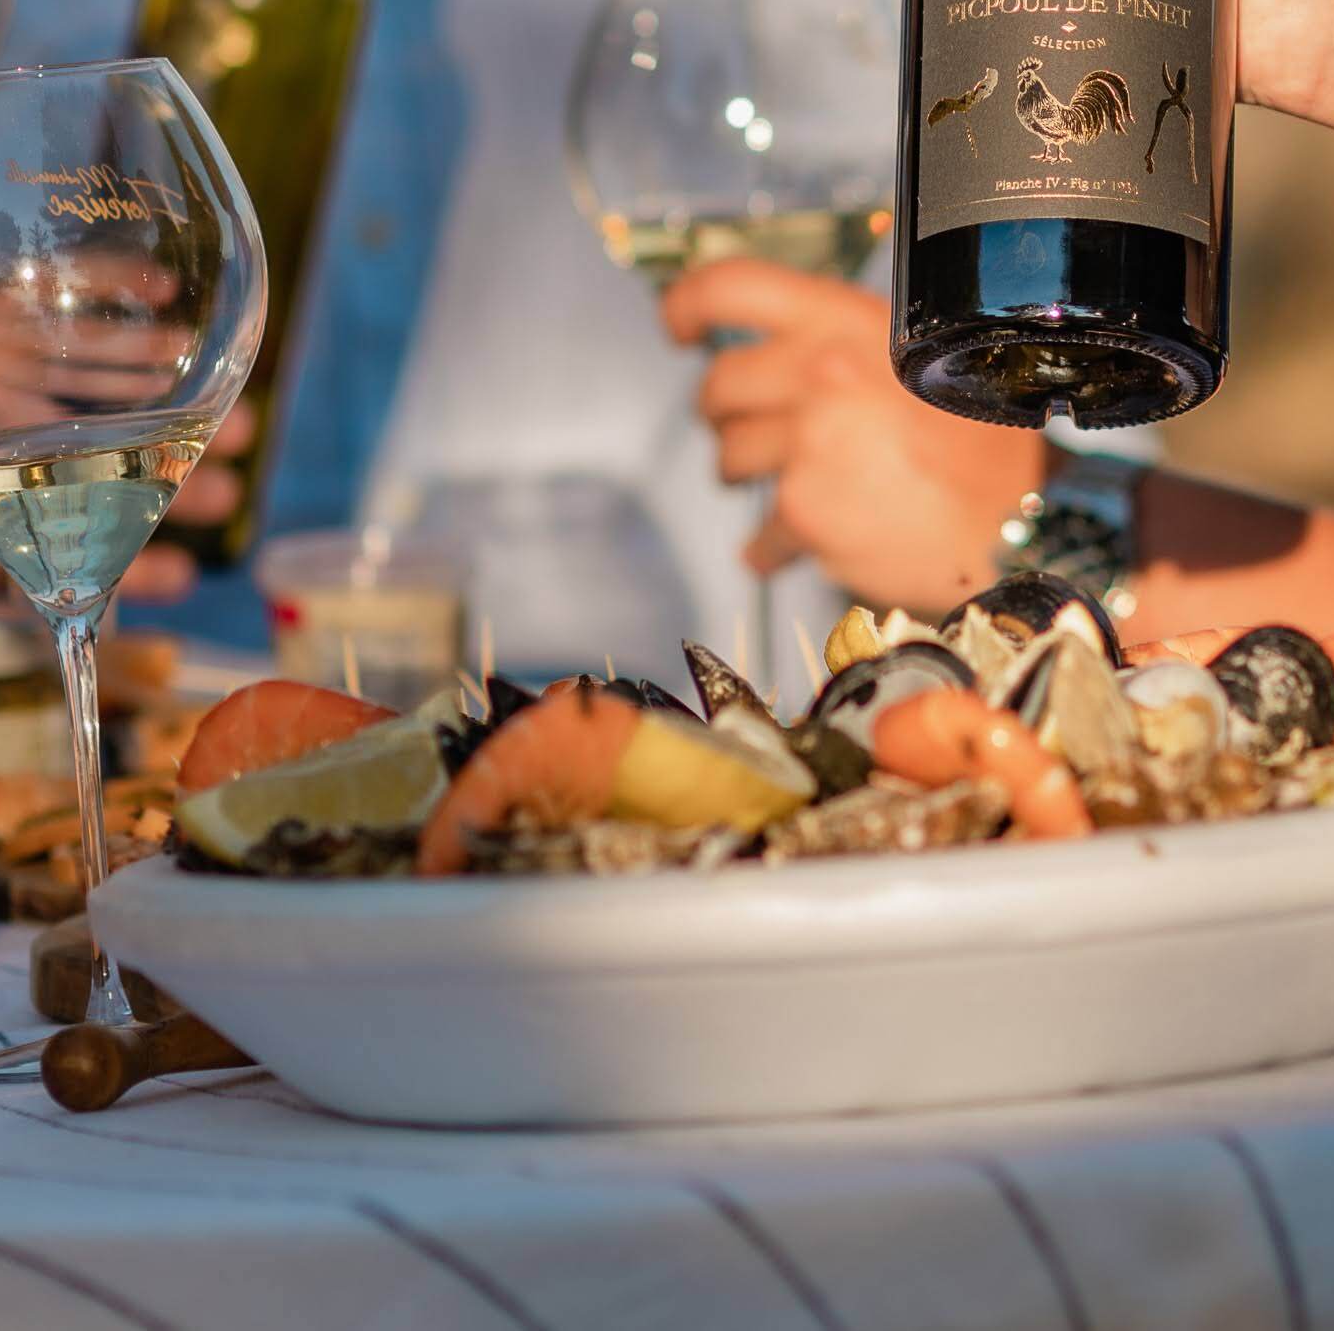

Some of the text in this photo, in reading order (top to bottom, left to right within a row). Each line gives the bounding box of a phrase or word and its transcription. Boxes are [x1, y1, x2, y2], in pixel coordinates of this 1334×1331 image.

[1032, 35, 1107, 51] SÉLECTION
[994, 178, 1042, 192] Planche
[1046, 177, 1060, 189] IV
[1070, 177, 1089, 191] Fig
